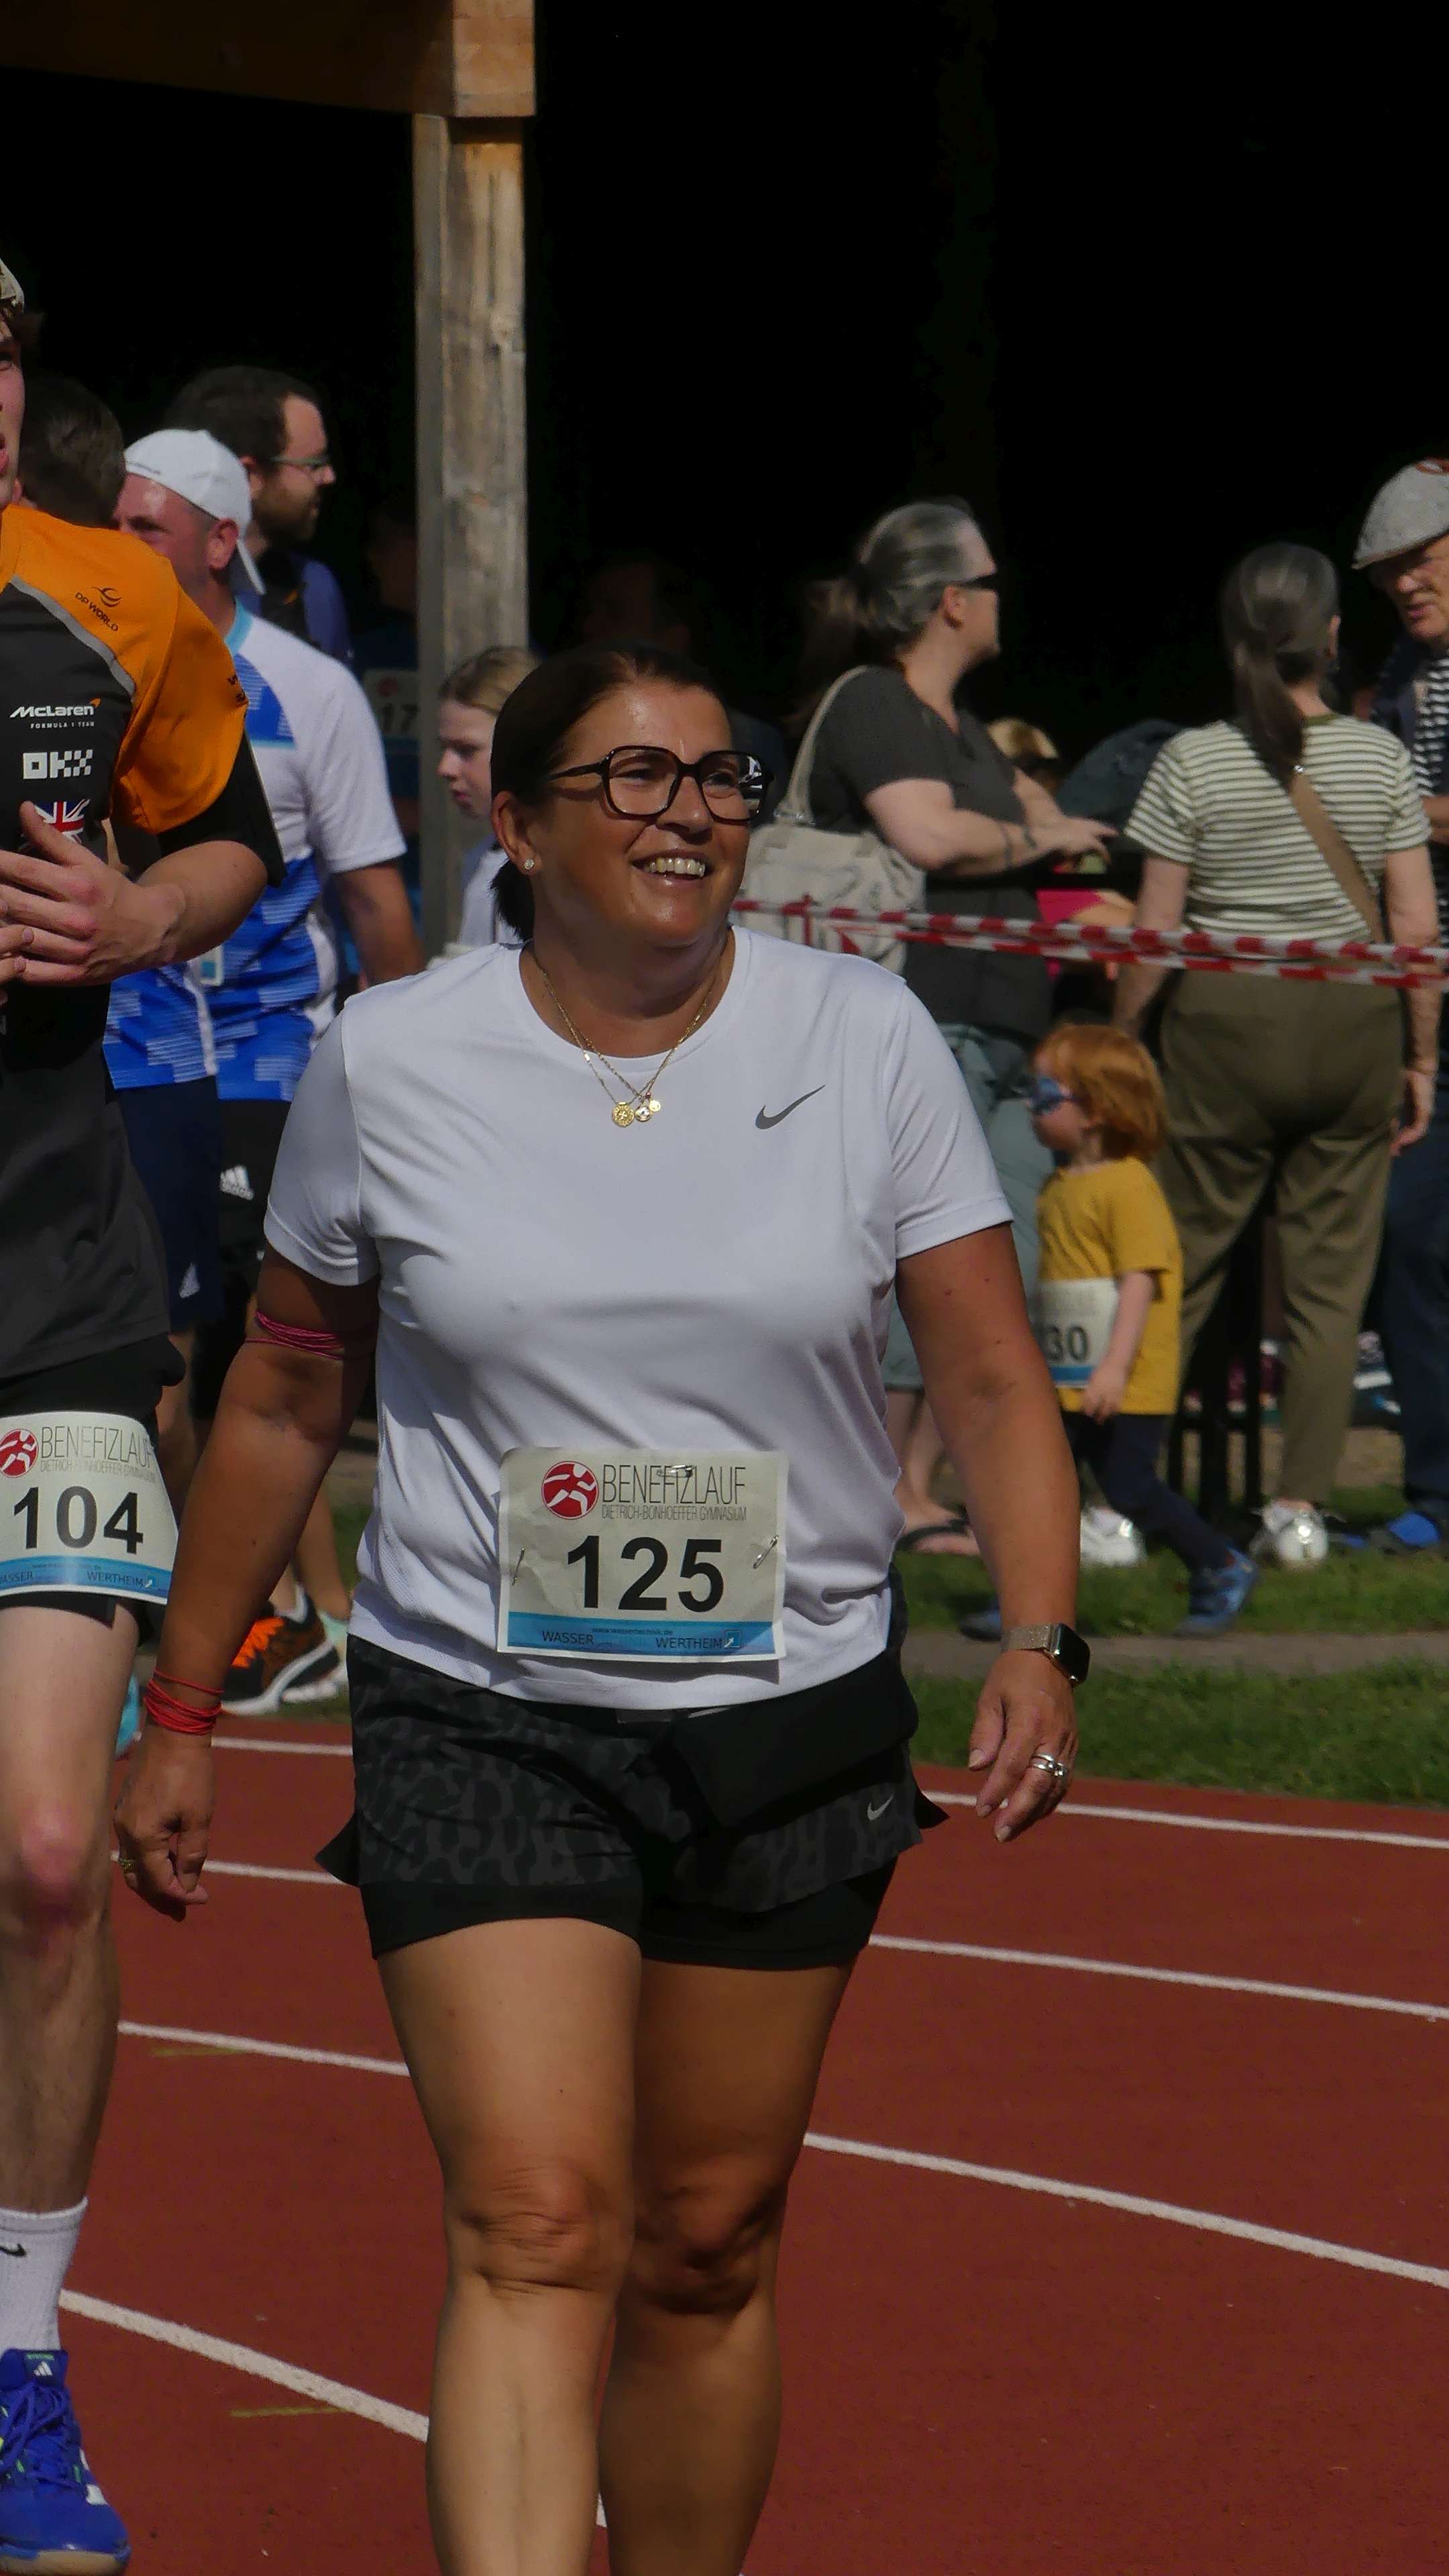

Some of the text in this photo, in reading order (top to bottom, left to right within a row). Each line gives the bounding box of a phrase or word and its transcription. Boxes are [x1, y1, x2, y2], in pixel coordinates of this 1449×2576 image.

[74, 592, 119, 631] DP WORLD
[9, 705, 95, 718] McLaren
[22, 749, 94, 780] OKX
[602, 1464, 746, 1505] BENEFIZLAUF
[13, 1485, 144, 1555] 104
[0, 1572, 34, 1586] ASSER
[568, 1535, 724, 1613] 125
[542, 1630, 722, 1649] WASSER WERTHEIM
